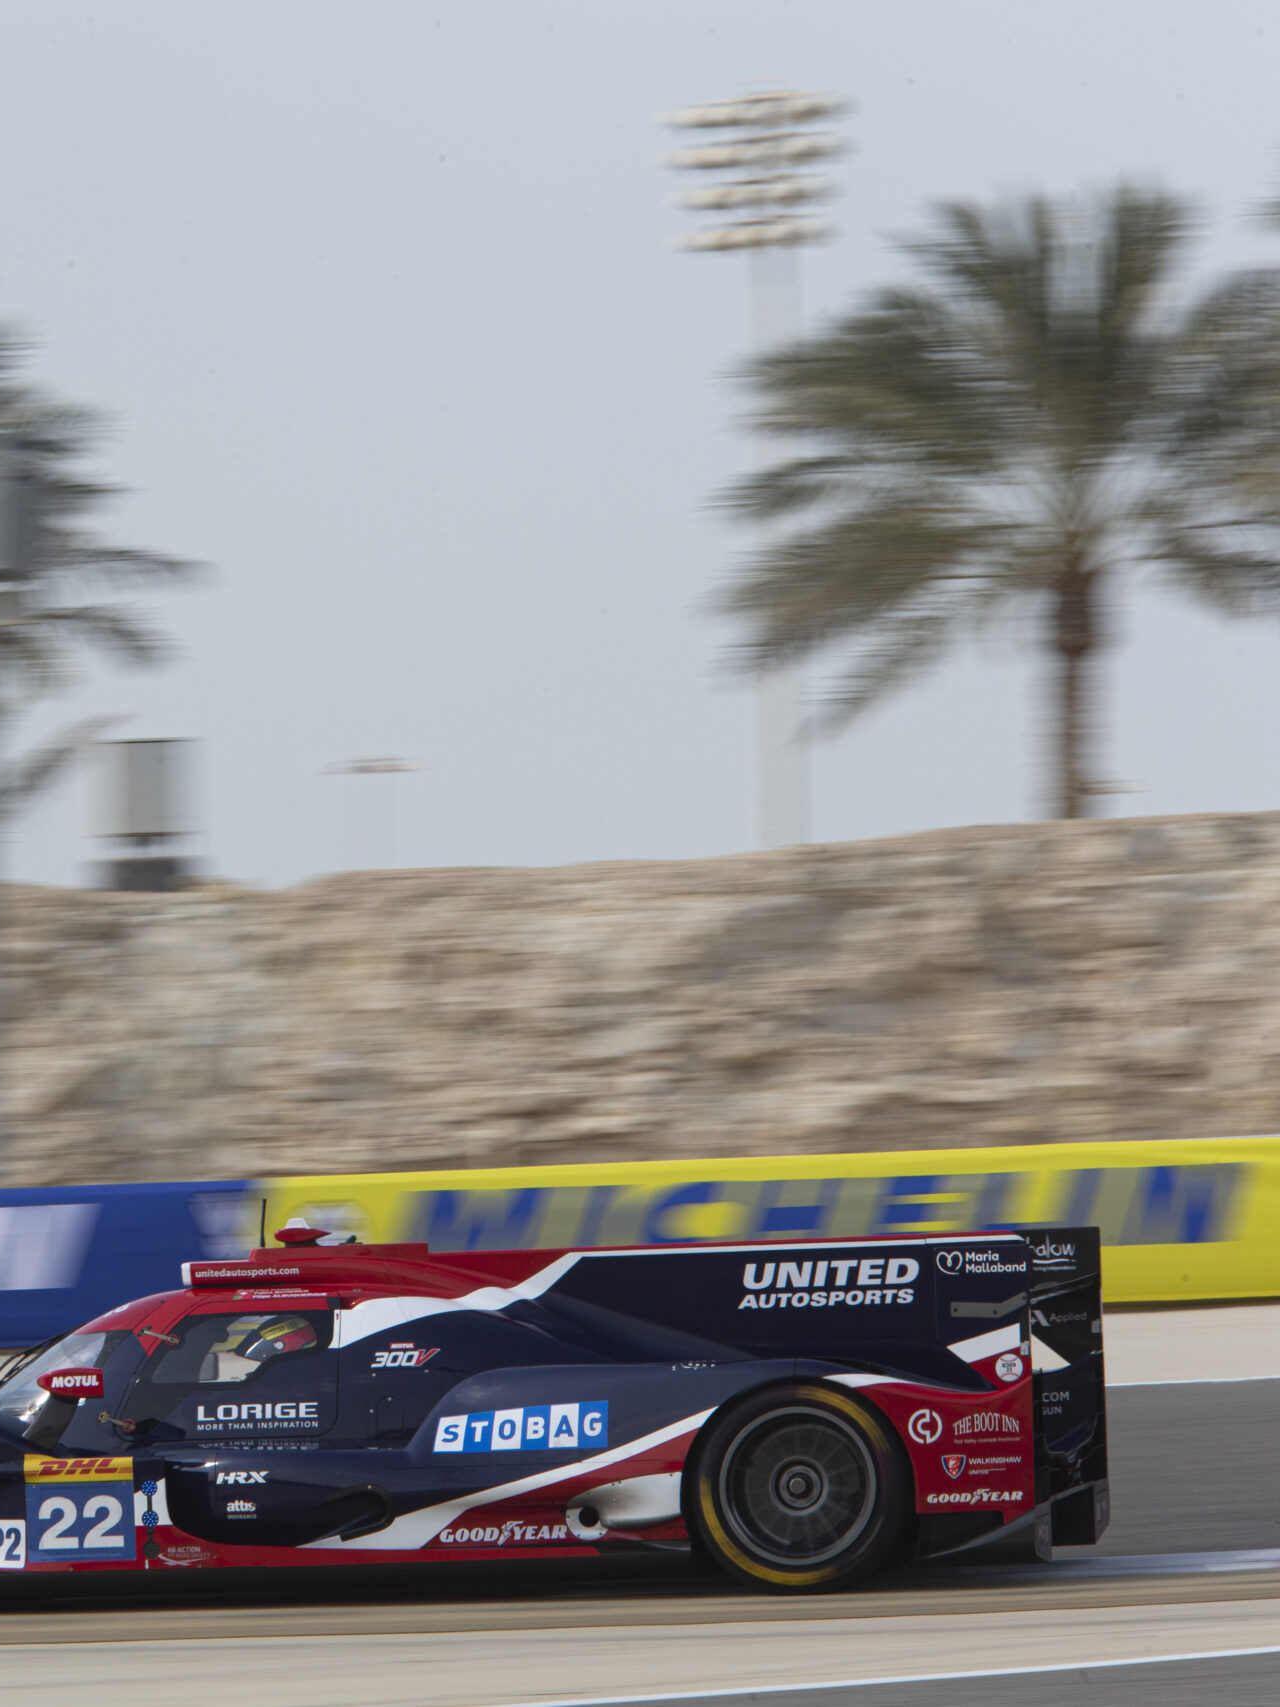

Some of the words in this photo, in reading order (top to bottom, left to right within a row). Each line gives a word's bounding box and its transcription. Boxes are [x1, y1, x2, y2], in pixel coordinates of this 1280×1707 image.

[965, 1250, 1000, 1262] Maria
[195, 1267, 300, 1279] unitedautosports.com
[742, 1258, 920, 1290] UNITED
[965, 1261, 1027, 1273] Mallaband
[738, 1288, 915, 1310] AUTOSPORTS
[371, 1348, 441, 1368] 300V
[51, 1375, 99, 1388] MOTUL
[197, 1402, 319, 1421] LORIGE
[197, 1423, 224, 1431] MORE
[228, 1421, 254, 1430] THAN
[257, 1421, 319, 1429] INSPIRATION
[440, 1412, 603, 1443] STOBAG
[953, 1415, 972, 1435] THE
[973, 1412, 1000, 1432] BOOT
[1001, 1414, 1020, 1433] INN
[38, 1458, 120, 1476] DHL
[968, 1456, 1022, 1465] WALKINSHAW
[216, 1470, 270, 1485] HRX
[927, 1489, 1024, 1504] GOODYEAR
[226, 1499, 256, 1512] attis
[38, 1495, 125, 1550] 22
[439, 1521, 568, 1544] GOODYEAR
